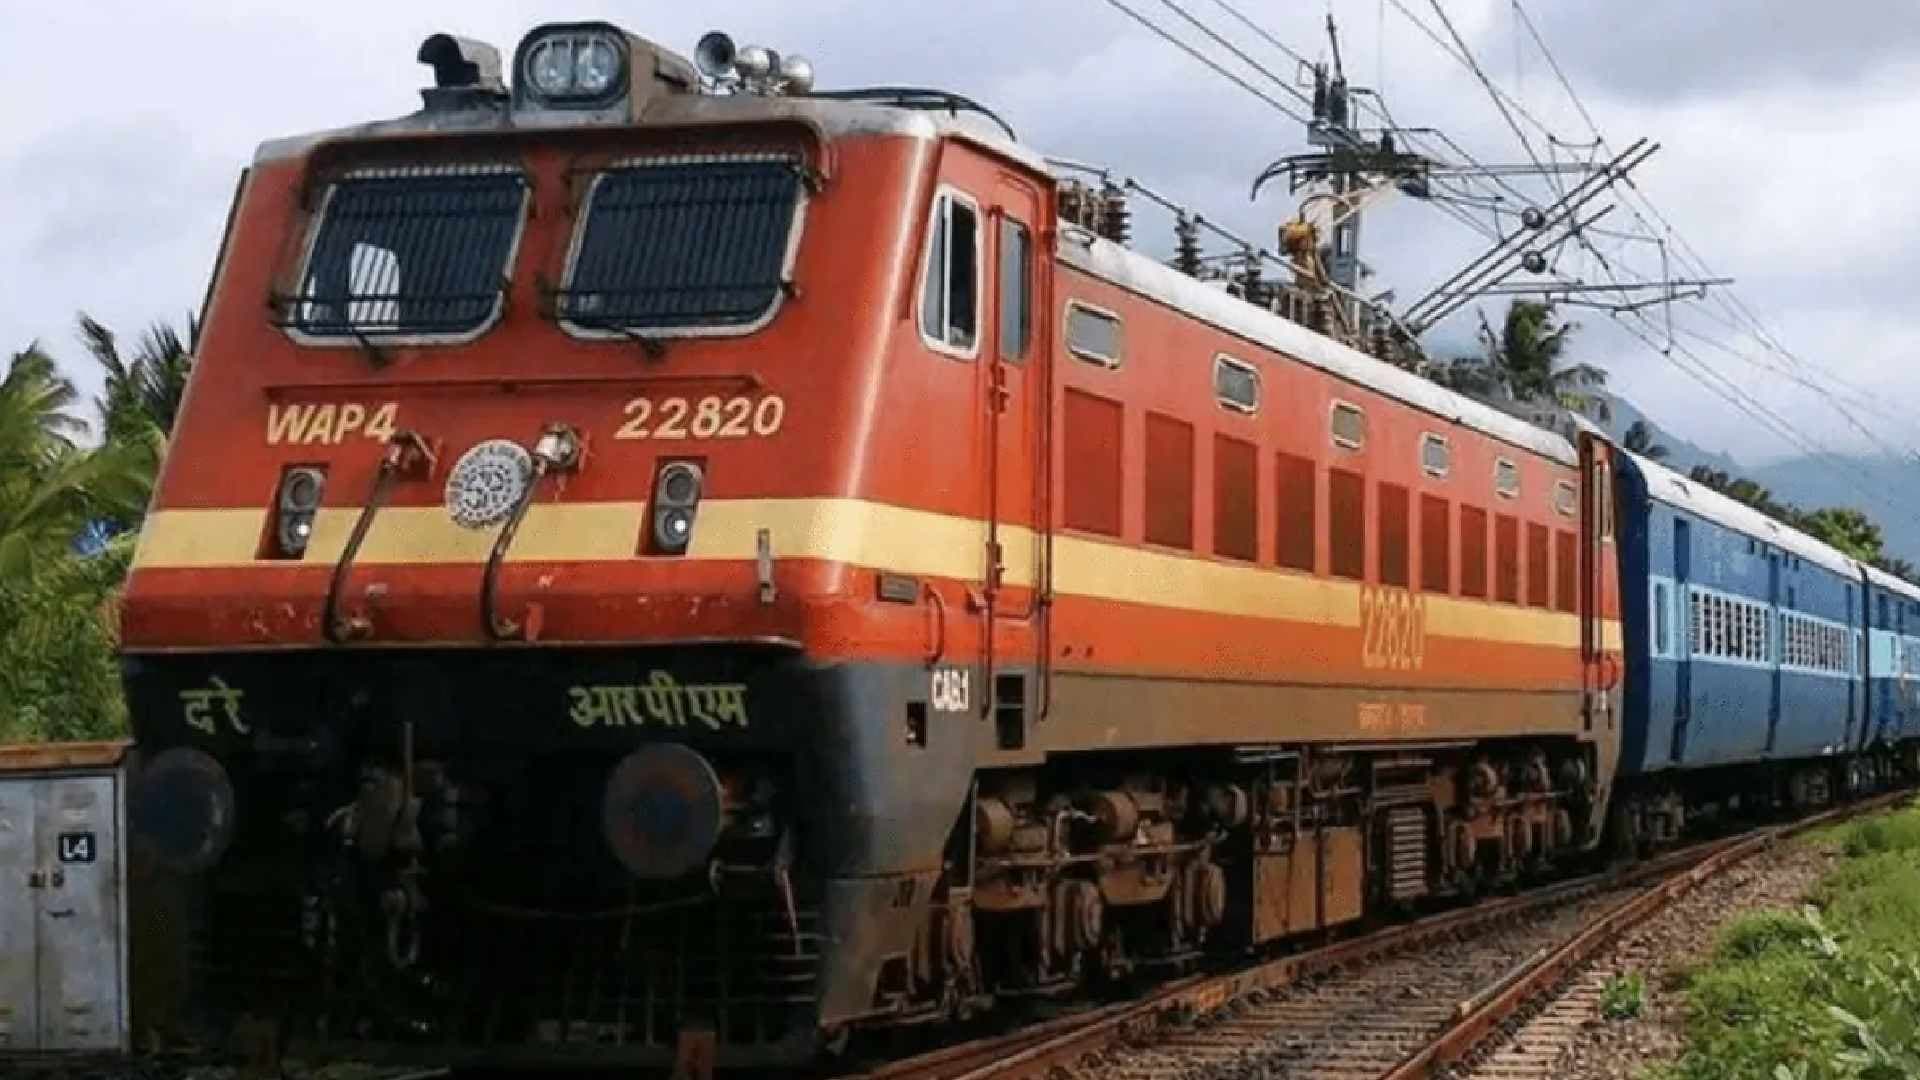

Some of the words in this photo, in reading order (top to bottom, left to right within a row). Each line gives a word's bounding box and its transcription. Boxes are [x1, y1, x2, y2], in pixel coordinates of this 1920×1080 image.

[266, 402, 399, 444] WAP4
[613, 395, 784, 441] 22820
[1361, 585, 1425, 671] 22820
[568, 669, 749, 730] आरपीएम
